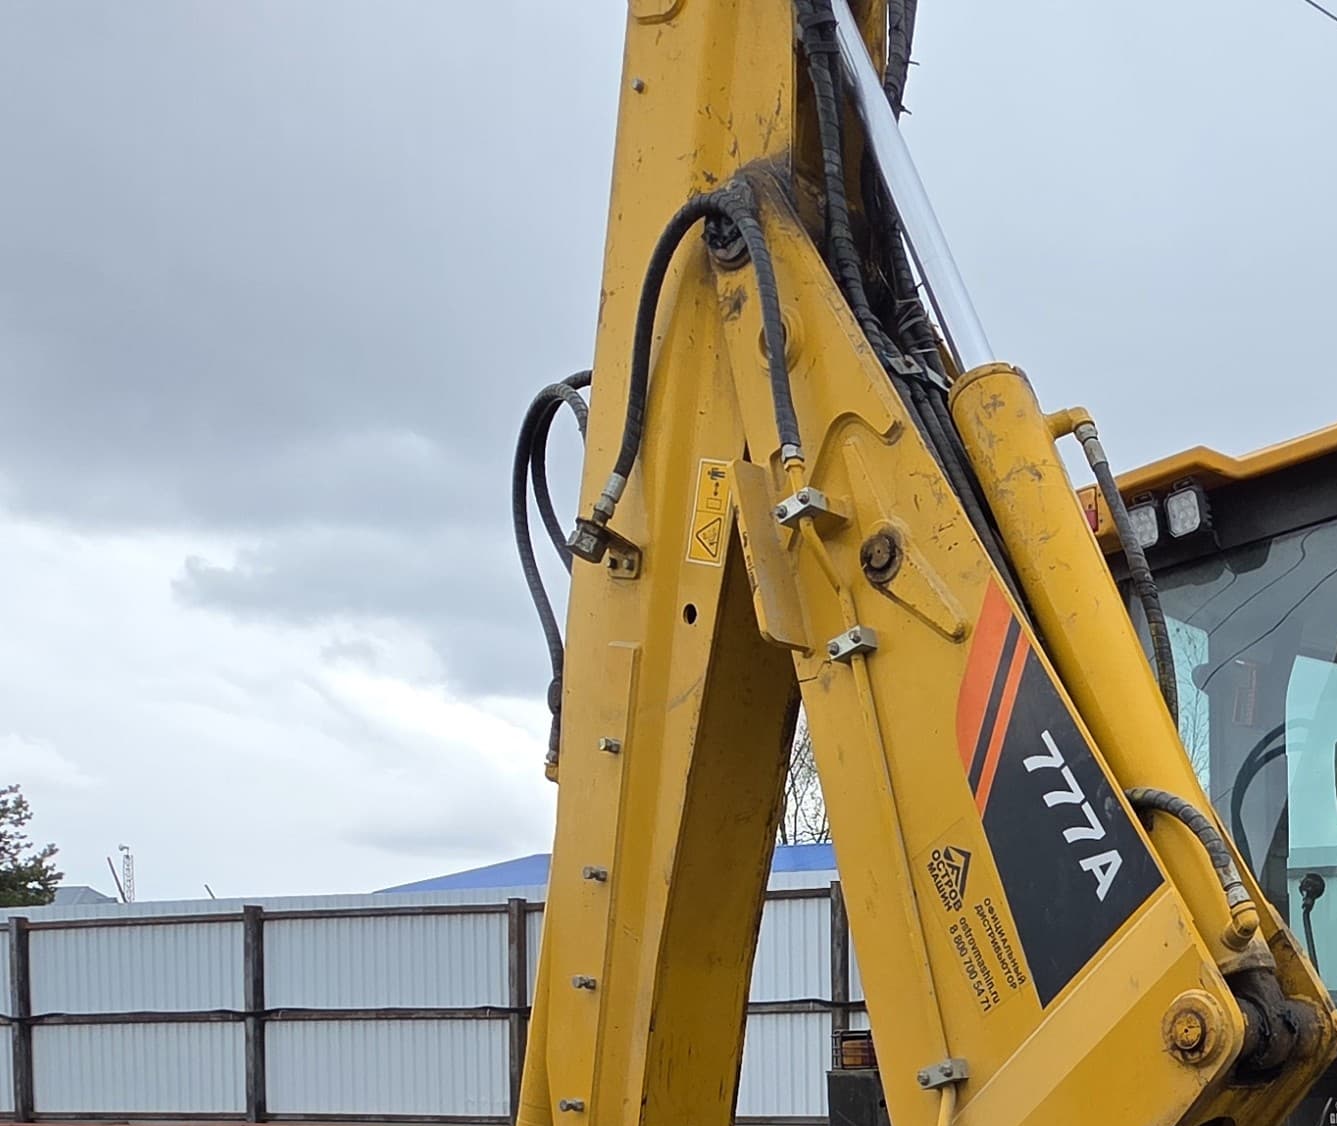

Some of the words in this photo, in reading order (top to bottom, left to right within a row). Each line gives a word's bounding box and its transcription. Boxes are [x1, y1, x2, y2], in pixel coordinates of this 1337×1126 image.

[1023, 730, 1123, 902] 777A
[927, 861, 953, 912] МАШИН
[931, 849, 963, 912] ОСТРОВ
[950, 924, 958, 934] 8
[953, 935, 967, 957] 800
[974, 904, 1017, 989] ДИСТРИБЬЮТОР
[983, 897, 1026, 985] ОФИЦИАЛЬНЫЙ
[959, 917, 1000, 1004] ostrovmashin.ru
[964, 958, 977, 980] 700
[973, 980, 985, 996] 54
[980, 997, 992, 1012] 71
